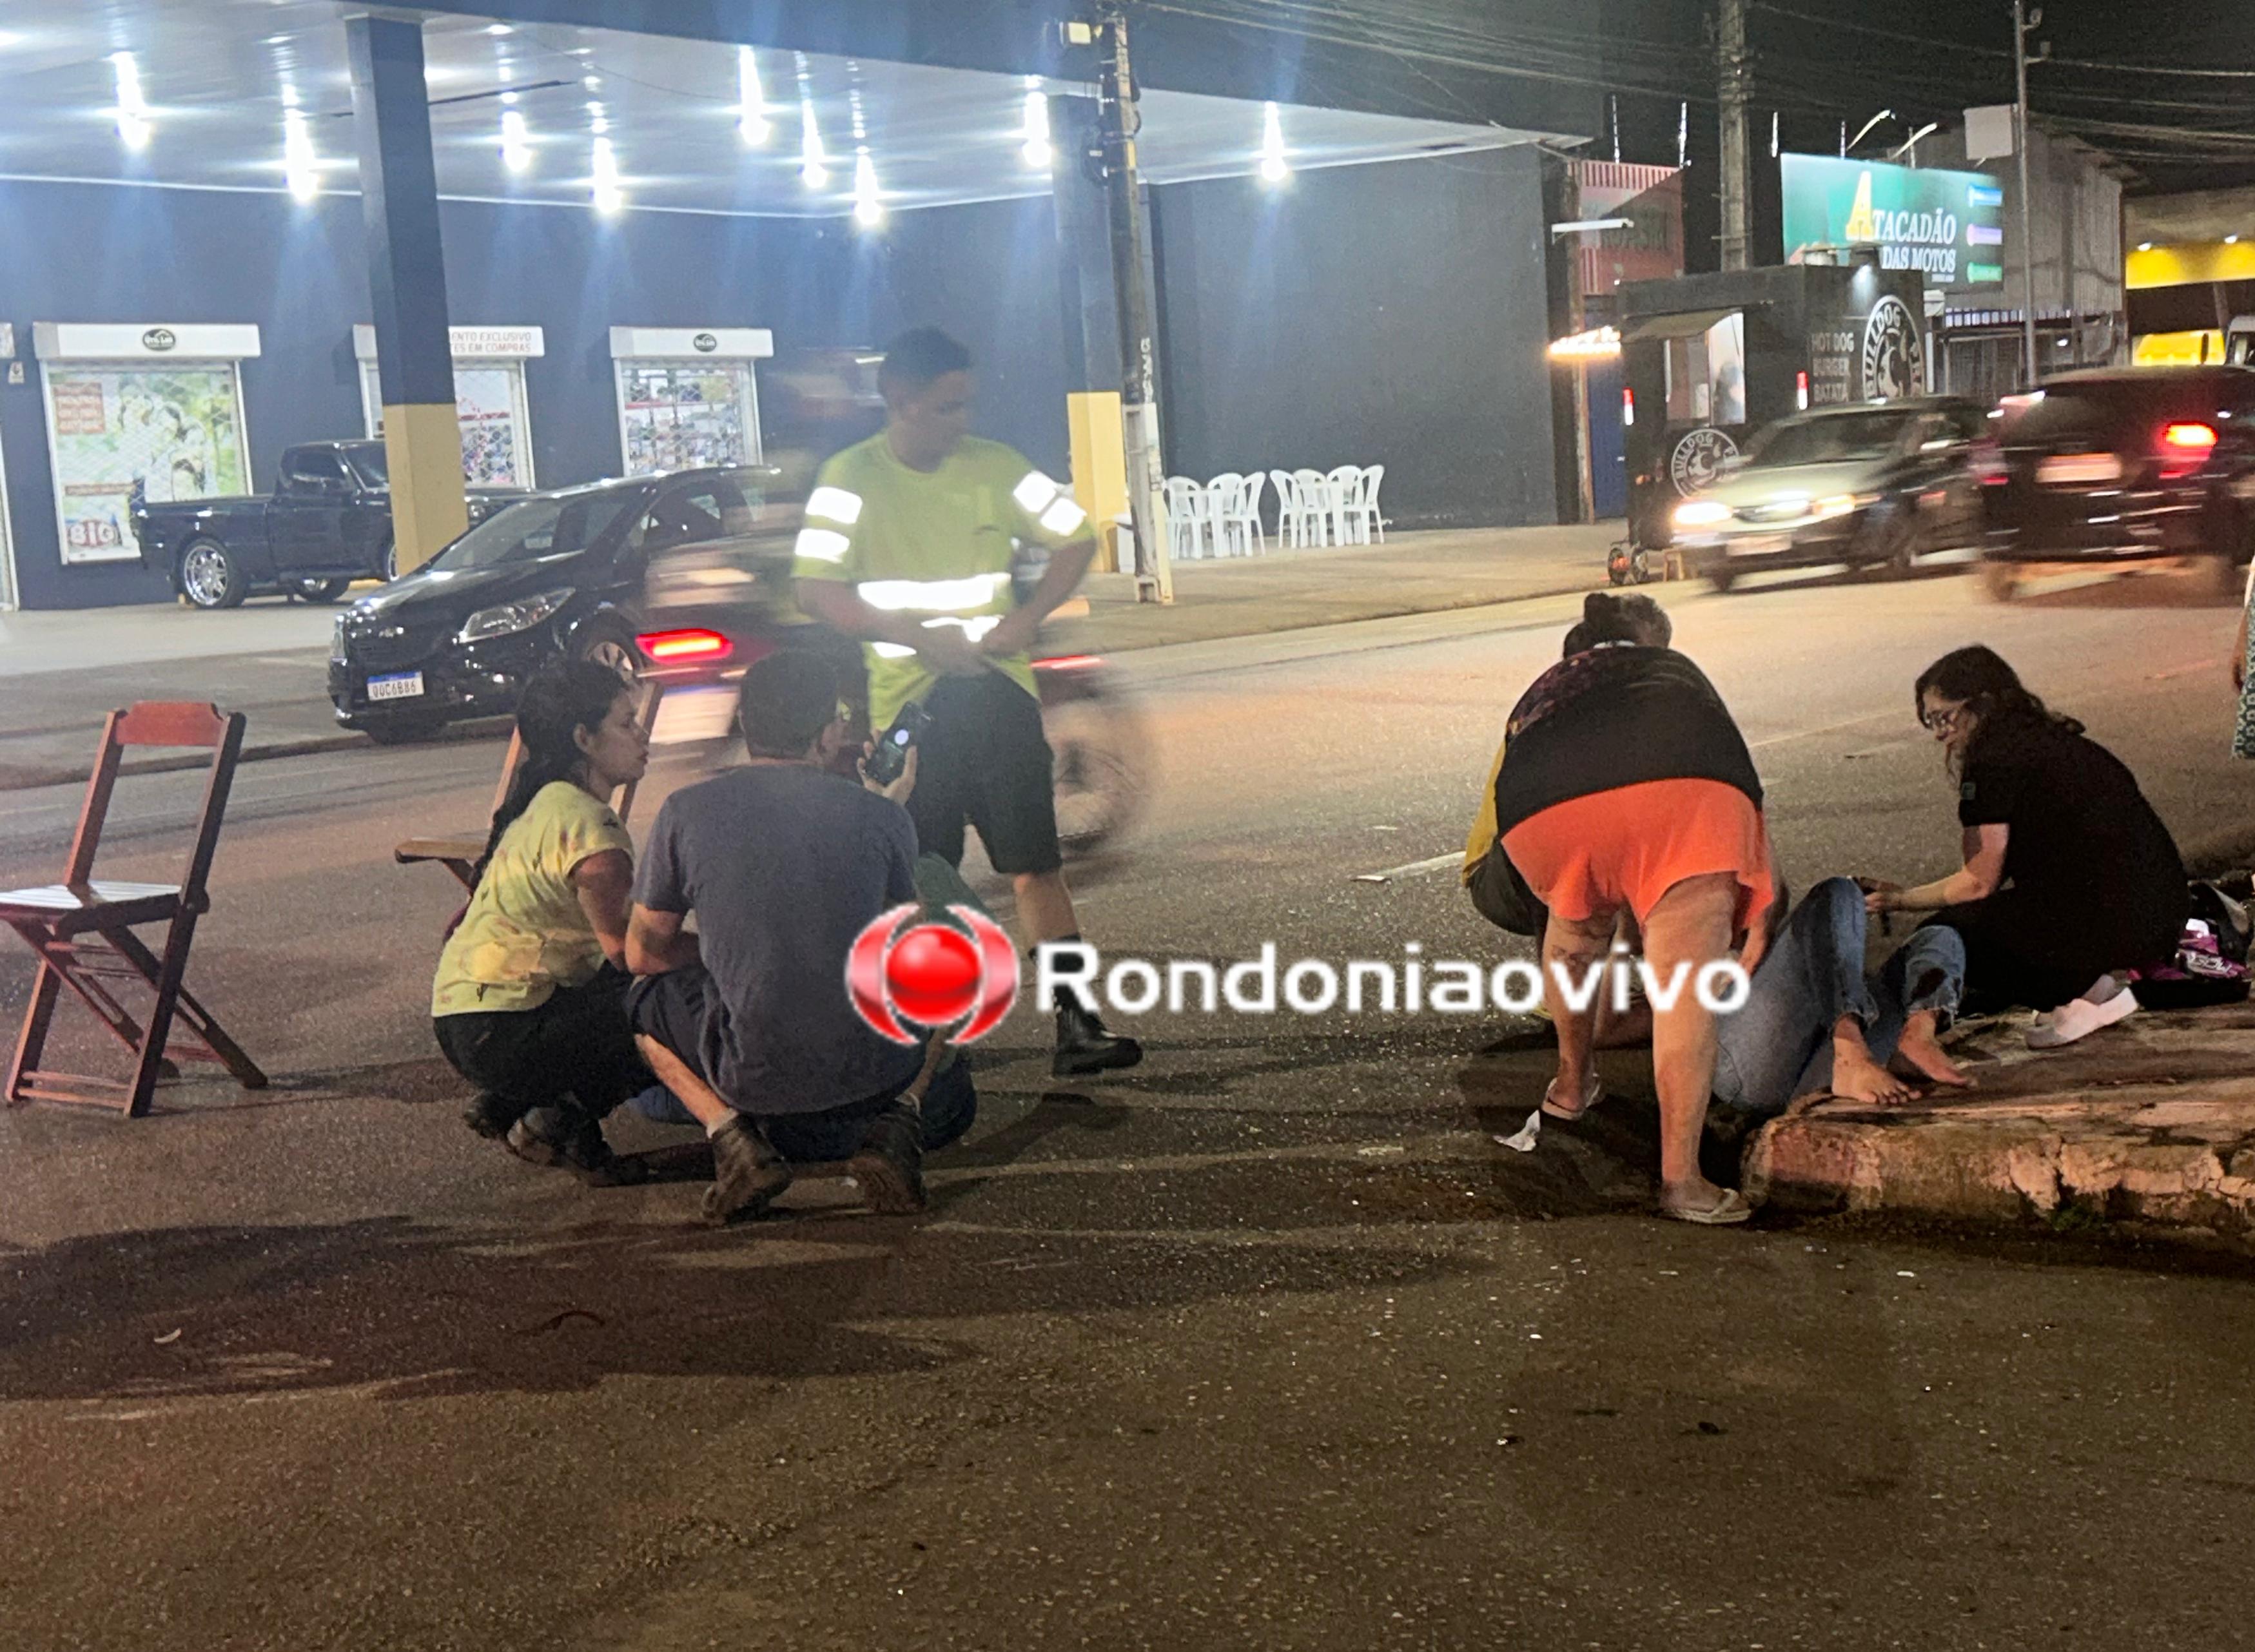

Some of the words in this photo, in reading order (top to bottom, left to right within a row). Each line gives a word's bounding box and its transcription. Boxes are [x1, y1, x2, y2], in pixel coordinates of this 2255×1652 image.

[1846, 171, 1957, 245] ATACADÃO
[1881, 246, 1910, 269] DAS
[1911, 248, 1957, 273] MOTOS
[480, 331, 532, 342] EXCLUSIVO
[1833, 332, 1855, 352] DOG
[468, 343, 482, 352] EM
[485, 343, 531, 352] COMPRAS
